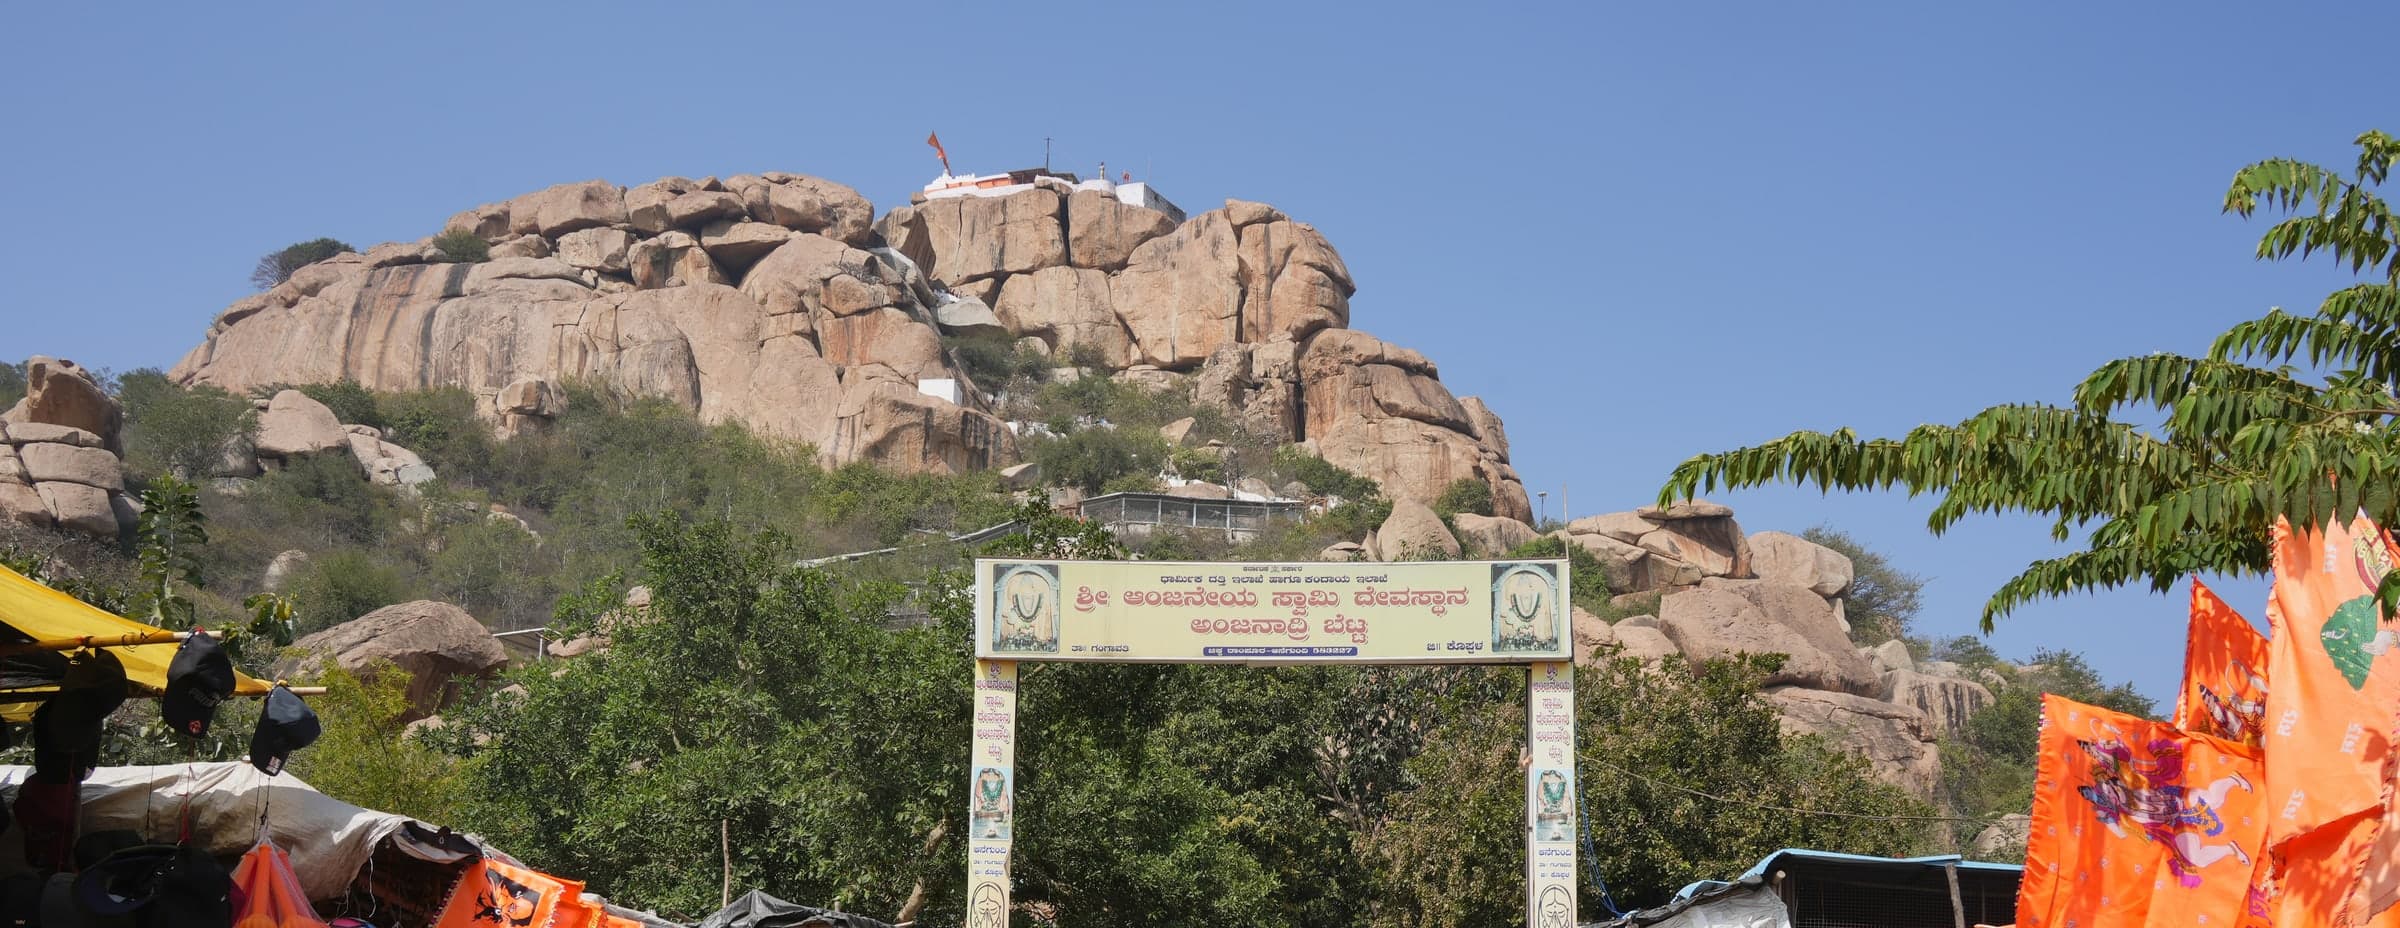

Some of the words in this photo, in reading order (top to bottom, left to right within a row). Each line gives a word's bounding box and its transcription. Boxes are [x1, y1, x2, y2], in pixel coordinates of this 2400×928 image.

[1231, 574, 1264, 584] ಇಲಾಖೆ
[1269, 575, 1302, 584] ಹಾಗೂ
[1304, 575, 1350, 584] ಕಂದಾಯ
[1356, 573, 1388, 584] ಇಲಾಖೆ
[1074, 586, 1110, 613] ಶ್ರೀ
[1123, 586, 1260, 608] ಆಂಜನೇಯ
[1271, 589, 1341, 616] ಸ್ವಾಮಿ
[1353, 585, 1470, 617] ದೇವಸ್ಥಾನ
[1190, 617, 1311, 642] ಅಂಜನಾದ್ರಿ
[1323, 614, 1368, 645] ಬೆಟ್ಟ
[1446, 640, 1484, 654] ಕೊಪ್ಪಳ
